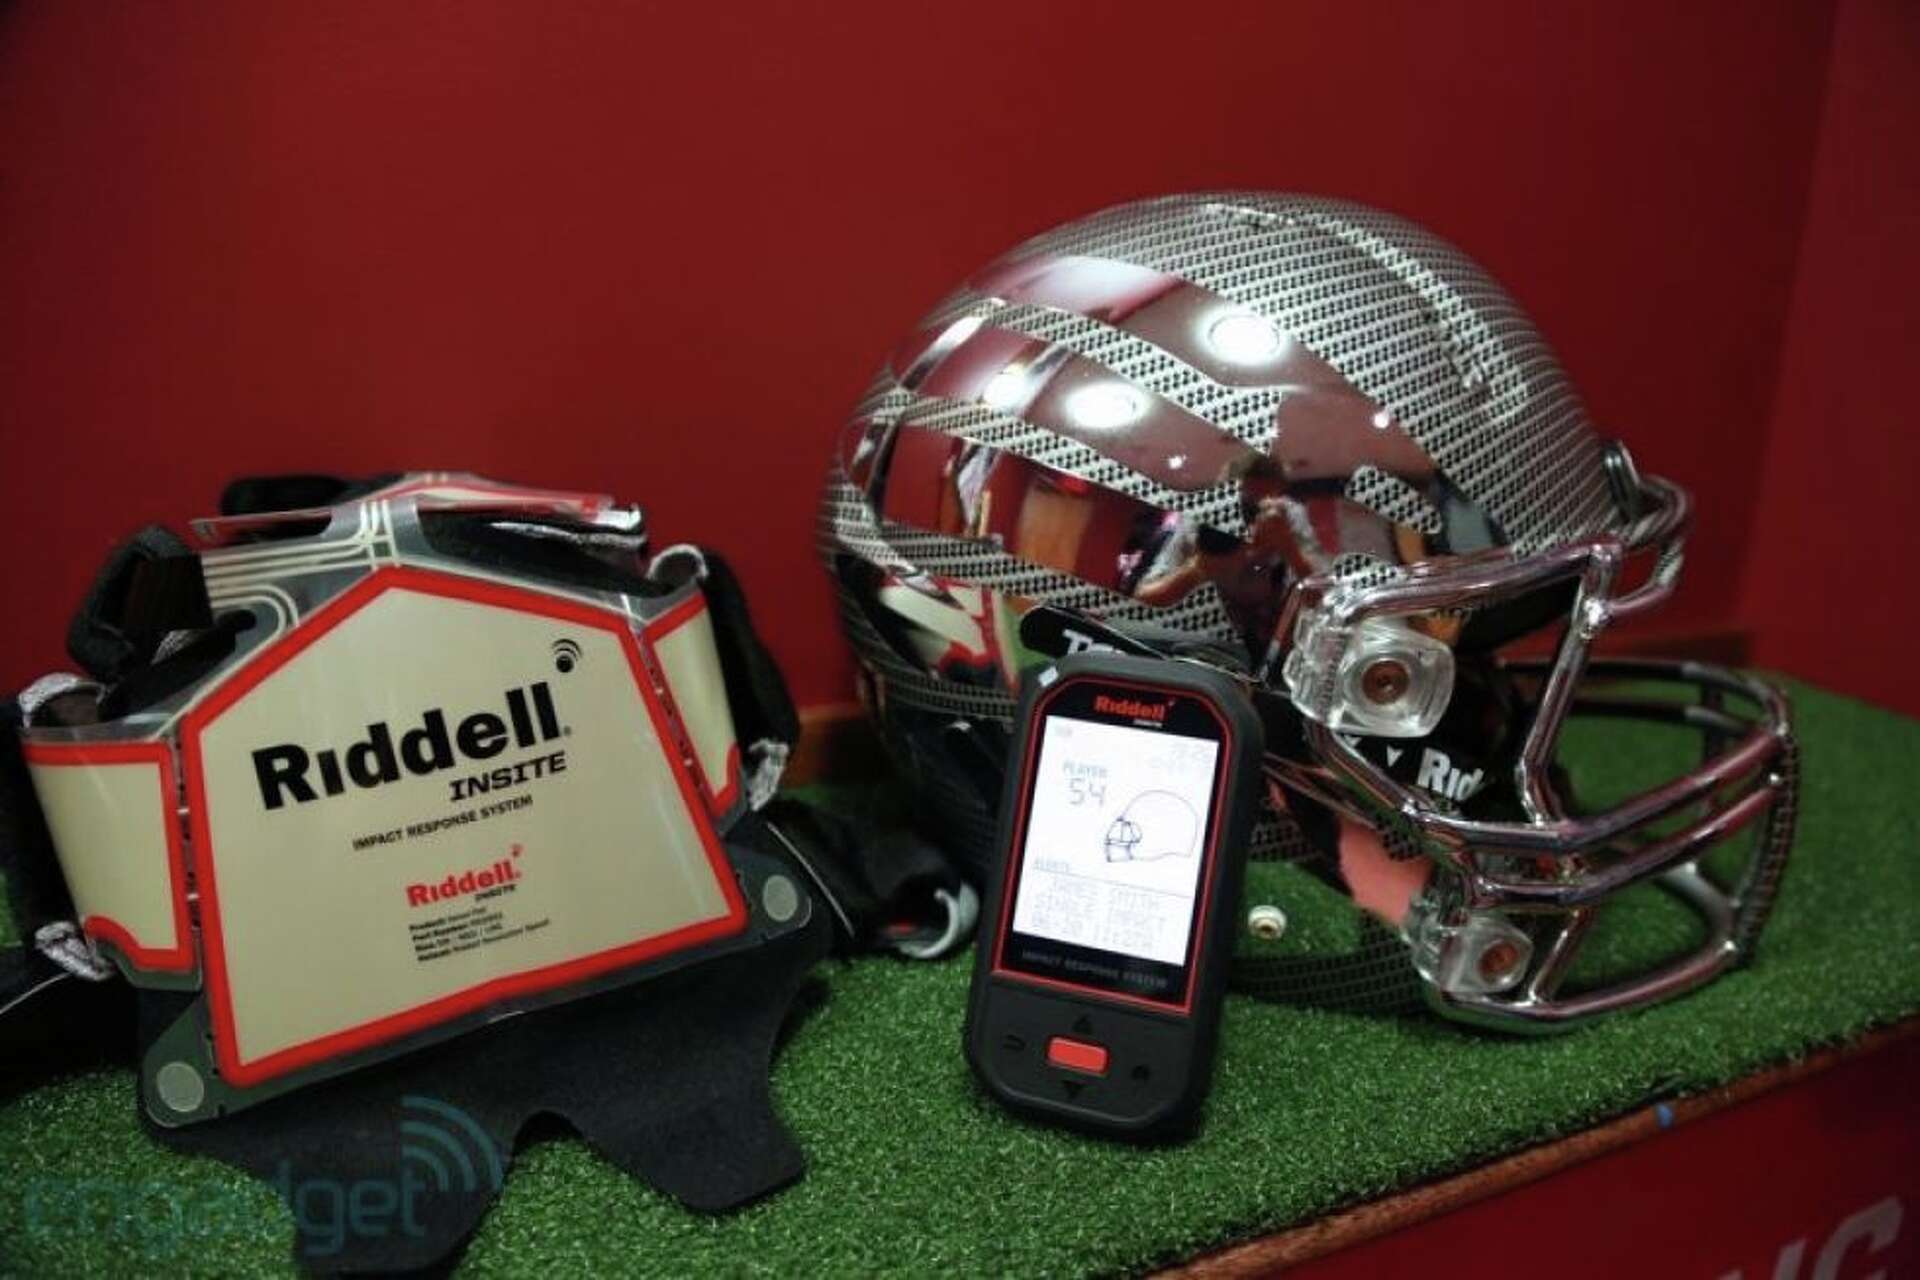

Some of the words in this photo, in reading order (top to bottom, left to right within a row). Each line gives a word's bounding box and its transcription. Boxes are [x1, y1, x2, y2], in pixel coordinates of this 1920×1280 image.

[1094, 695, 1165, 721] Riddell
[252, 681, 561, 810] Riddell
[449, 751, 567, 801] INSITE
[1069, 777, 1106, 806] 54
[352, 831, 403, 851] IMPACT
[407, 811, 478, 838] RESPONSE
[480, 795, 534, 819] SYSTEM
[405, 859, 515, 908] Riddell
